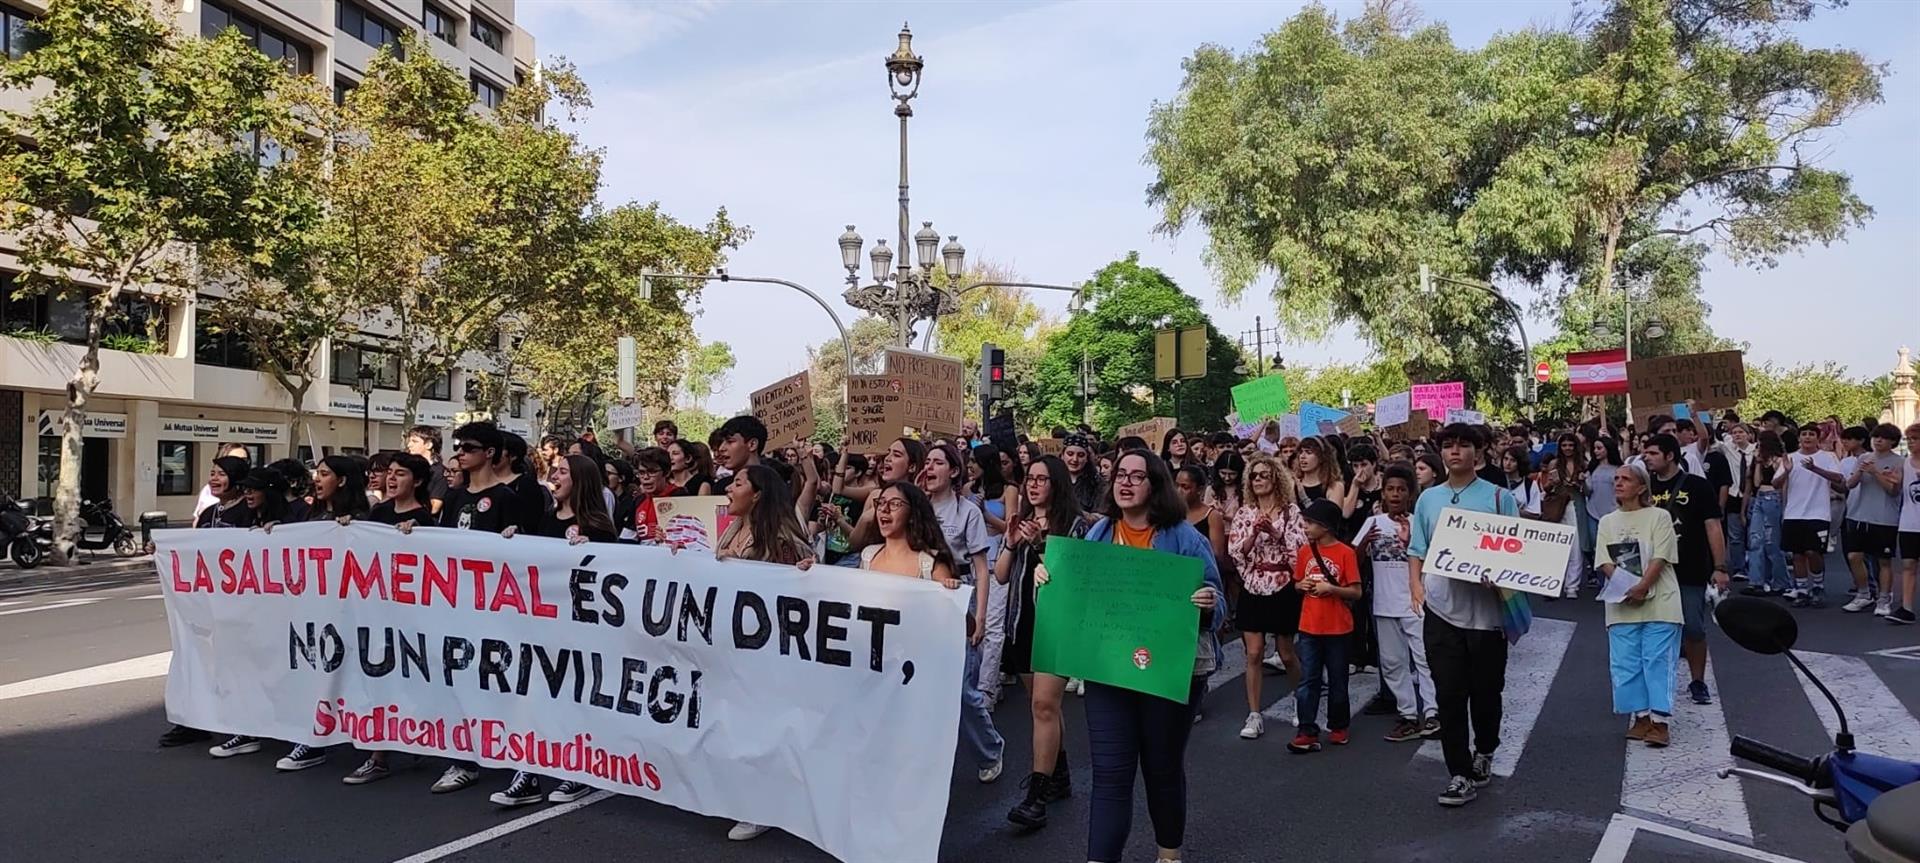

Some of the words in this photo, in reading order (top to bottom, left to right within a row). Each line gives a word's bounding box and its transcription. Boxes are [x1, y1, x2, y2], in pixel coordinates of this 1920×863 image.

[888, 354, 906, 374] NO
[1634, 378, 1653, 391] LA
[1709, 381, 1740, 399] TCA
[754, 383, 793, 409] MIENTRAS
[94, 417, 126, 428] Universal
[770, 407, 796, 425] ESTADO
[174, 423, 193, 432] Mutua
[193, 424, 219, 433] Universal
[238, 426, 254, 434] Mutua
[255, 427, 278, 435] Universal
[852, 429, 878, 446] MORIR
[1446, 514, 1468, 530] Mi
[1524, 527, 1574, 546] mental
[1479, 534, 1523, 554] NO
[1495, 567, 1561, 591] precio
[169, 548, 214, 594] LA
[218, 547, 333, 597] SALUT
[338, 550, 558, 619] MENTAL
[569, 554, 629, 628] ÉS
[641, 578, 718, 646] UN
[731, 590, 915, 685] DRET,
[289, 621, 345, 674] NO
[357, 626, 431, 683] UN
[443, 635, 702, 729] PRIVILEGI
[313, 698, 447, 751] Sindicat
